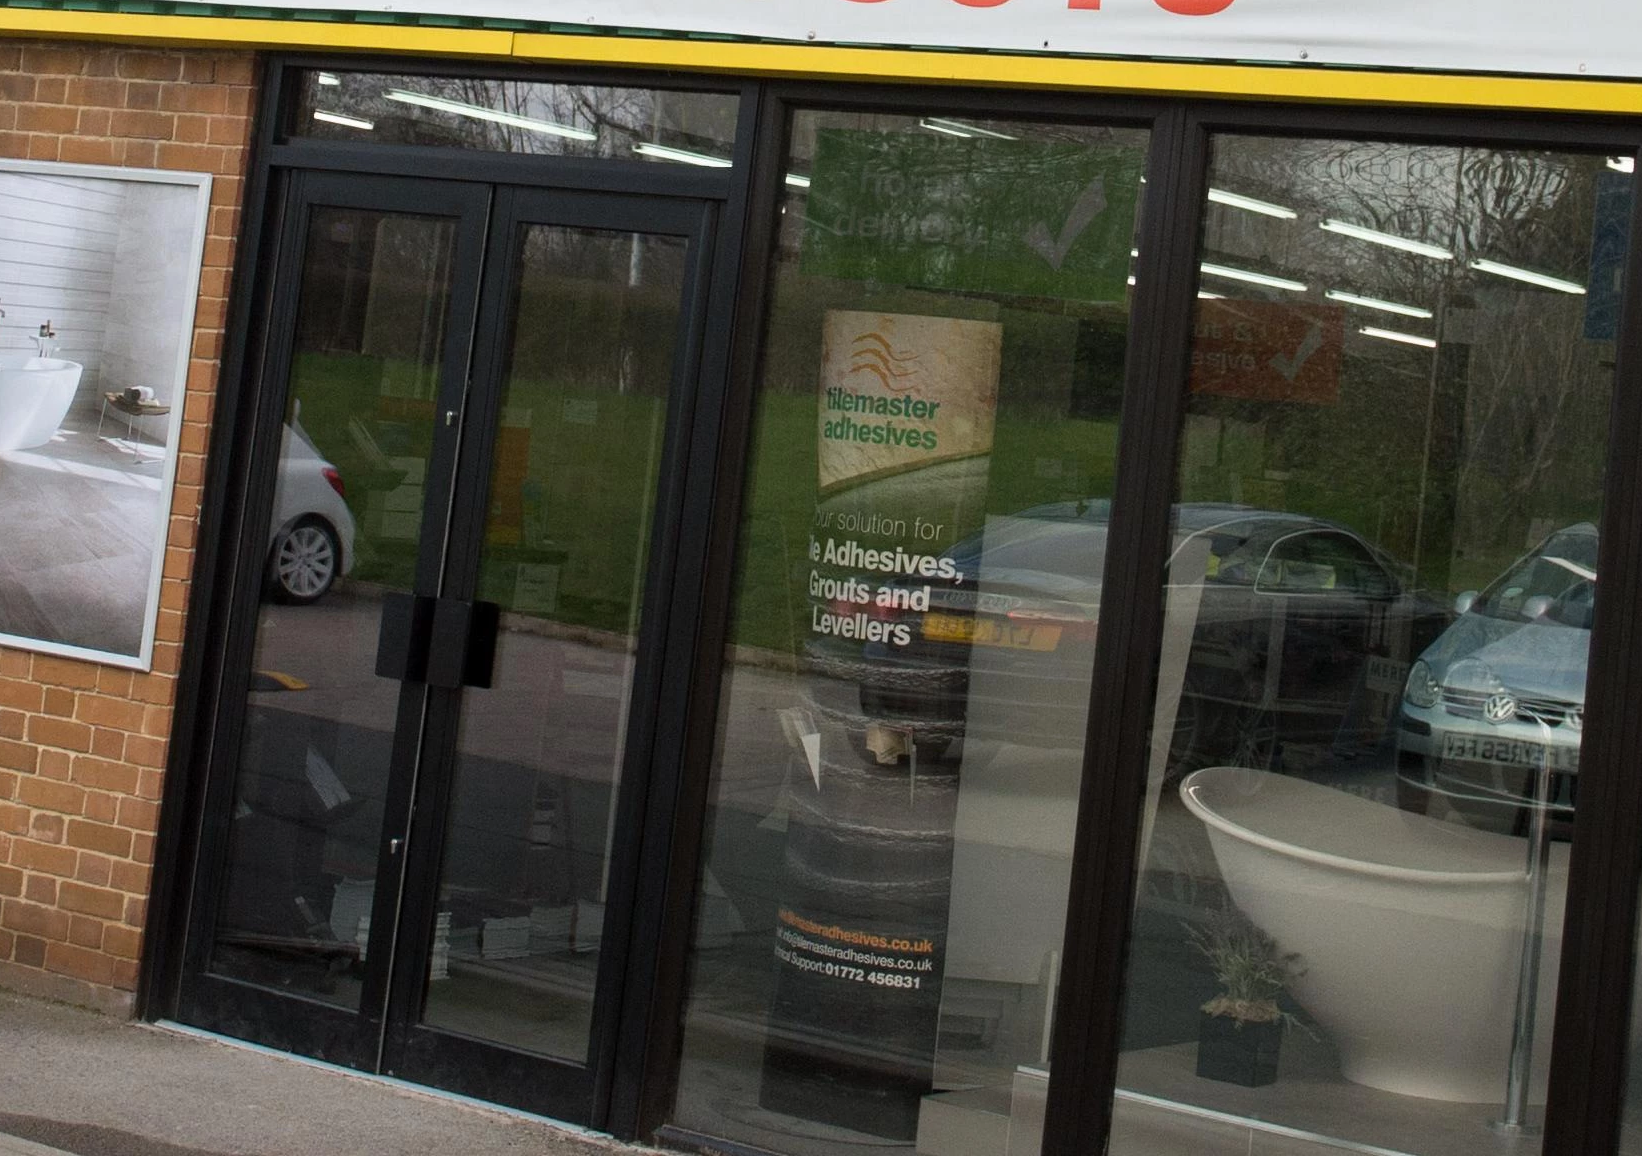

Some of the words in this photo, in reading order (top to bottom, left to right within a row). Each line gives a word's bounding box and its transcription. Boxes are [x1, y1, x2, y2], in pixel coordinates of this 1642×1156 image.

[825, 387, 940, 420] tilemaster
[824, 417, 938, 450] adhesives
[837, 510, 906, 538] solution
[914, 516, 944, 541] for
[823, 538, 964, 585] Adhesives,
[810, 570, 870, 605] Grouts
[876, 586, 931, 612] and
[812, 606, 911, 646] Levellers
[825, 962, 864, 981] 01772
[867, 971, 921, 989] 456831
